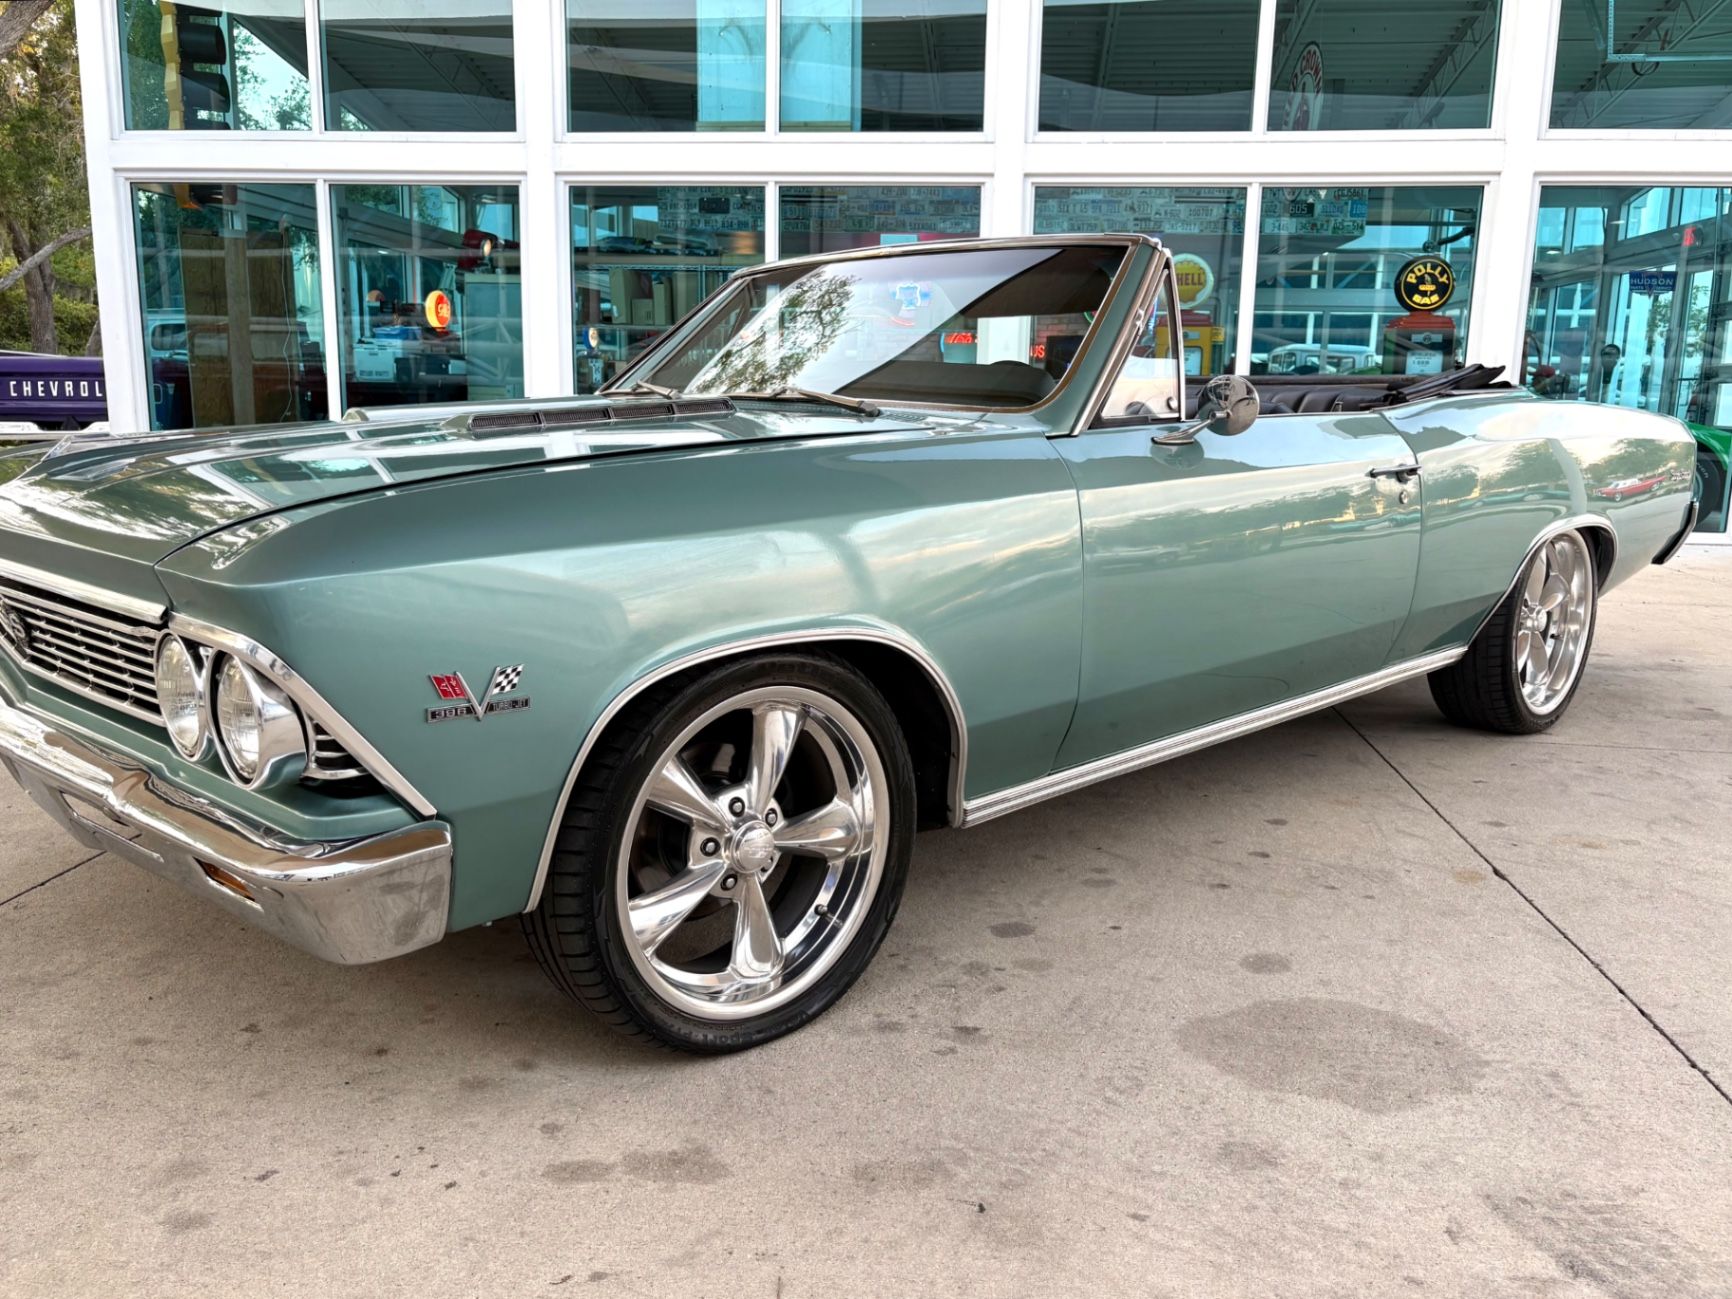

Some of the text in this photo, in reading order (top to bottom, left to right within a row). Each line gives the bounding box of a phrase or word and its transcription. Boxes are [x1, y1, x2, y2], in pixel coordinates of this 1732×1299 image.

[1176, 272, 1202, 286] HELL
[1406, 262, 1449, 284] POLLY
[1630, 277, 1674, 286] HUDSON
[1412, 293, 1440, 305] GAS
[9, 381, 103, 397] CHEVROL
